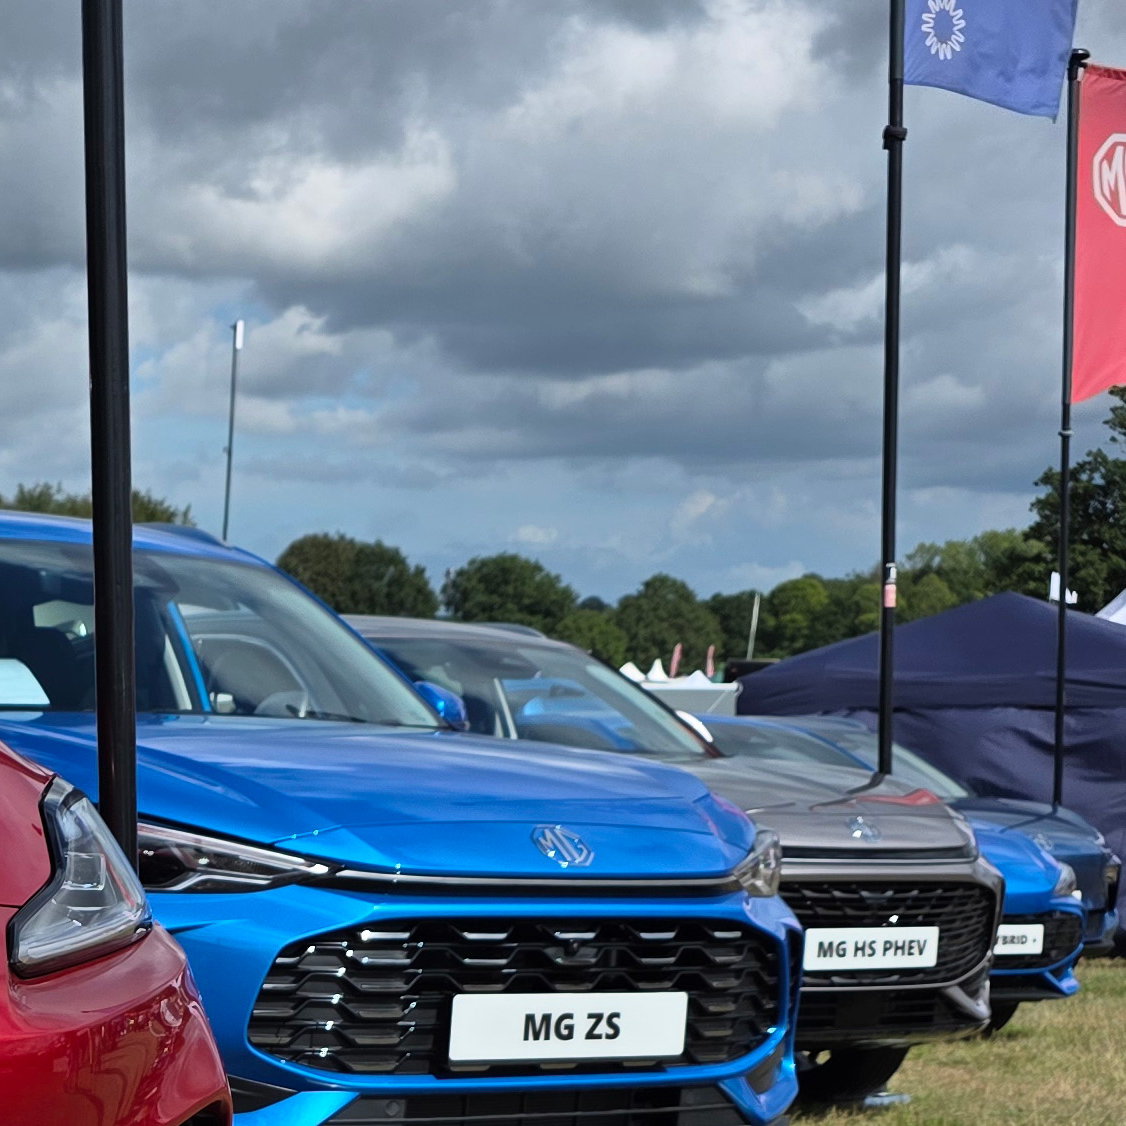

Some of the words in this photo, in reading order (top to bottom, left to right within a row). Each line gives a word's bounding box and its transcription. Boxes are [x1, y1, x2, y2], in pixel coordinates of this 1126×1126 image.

[1101, 145, 1126, 217] M
[538, 827, 589, 864] MG
[817, 940, 847, 958] MG
[853, 940, 877, 957] HS
[882, 939, 927, 957] PHEV
[522, 1013, 575, 1041] MG
[584, 1011, 622, 1040] ZS
